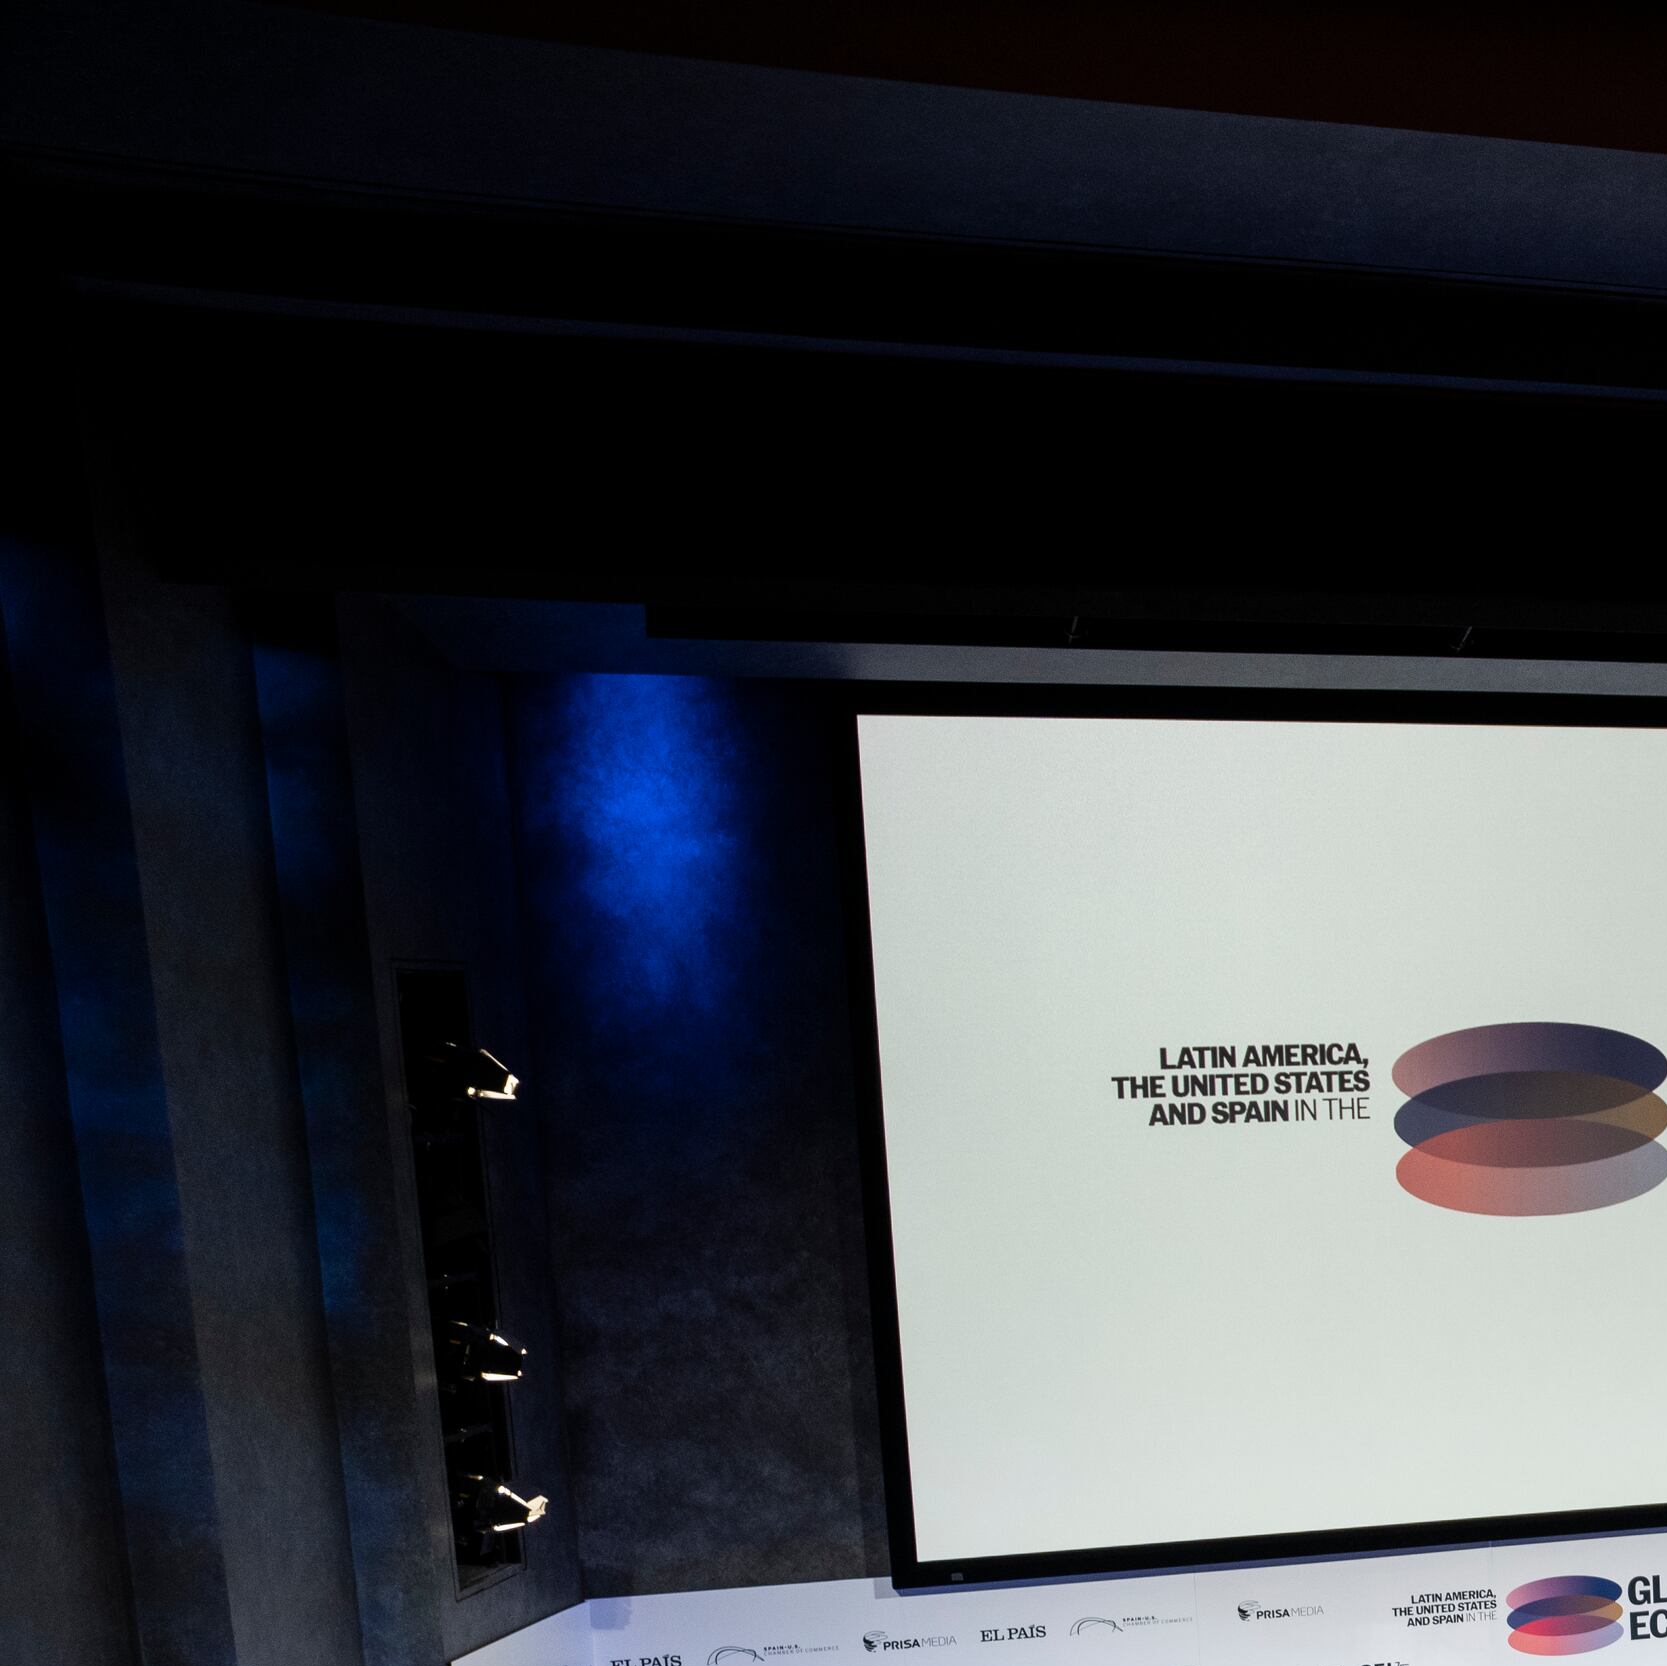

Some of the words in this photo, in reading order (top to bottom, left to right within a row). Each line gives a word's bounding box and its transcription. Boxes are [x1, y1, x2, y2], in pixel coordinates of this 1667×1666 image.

[1160, 1045, 1236, 1069] LATIN
[1242, 1043, 1369, 1068] AMERICA,
[1112, 1075, 1166, 1099] THE
[1172, 1073, 1269, 1097] UNITED
[1274, 1070, 1370, 1094] STATES
[1149, 1102, 1206, 1126] AND
[1212, 1100, 1289, 1124] SPAIN
[1295, 1098, 1317, 1121] IN
[1322, 1097, 1371, 1120] THE
[1411, 1591, 1443, 1604] LATIN
[1445, 1589, 1497, 1602] AMERICA,
[1392, 1606, 1413, 1616] THE
[1416, 1603, 1456, 1615] UNITED
[1459, 1599, 1497, 1612] STATES
[1407, 1615, 1429, 1627] AND
[1432, 1613, 1464, 1625] SPAIN
[1466, 1612, 1476, 1623] IN
[1478, 1610, 1497, 1622] THE
[980, 1630, 1004, 1642] EL
[1007, 1625, 1046, 1640] PAÍS
